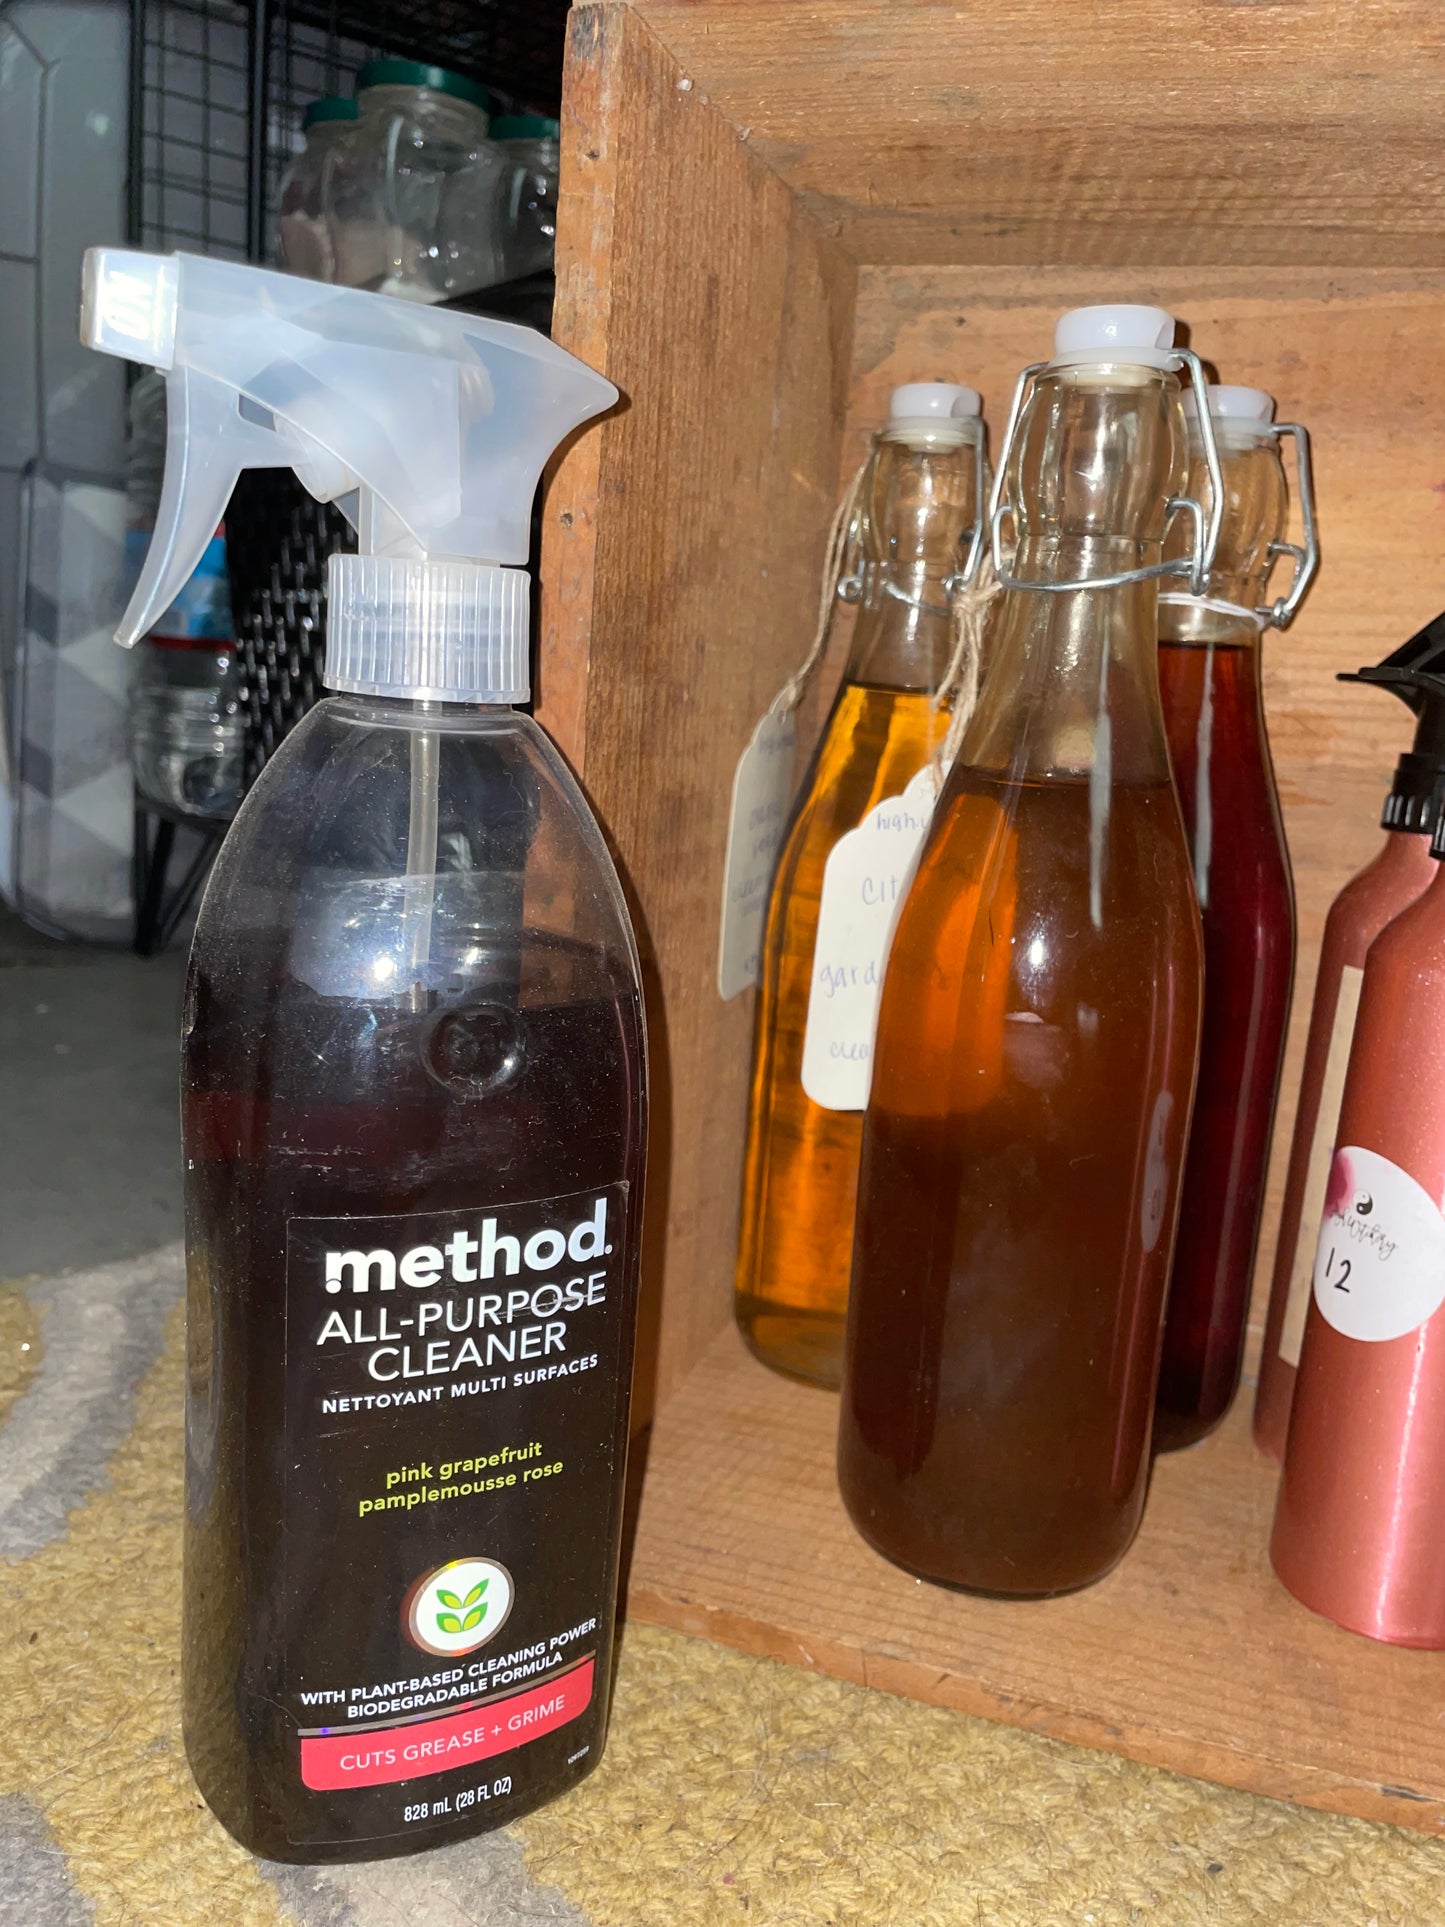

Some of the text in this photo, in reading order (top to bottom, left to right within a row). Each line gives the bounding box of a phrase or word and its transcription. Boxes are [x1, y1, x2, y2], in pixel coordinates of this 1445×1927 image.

[1325, 1247, 1352, 1294] 12
[316, 1270, 607, 1346] ALL-PURPOSE
[367, 1321, 567, 1382] CLEANER
[322, 1353, 599, 1414] NETTOYANT MULTI SURFACES
[358, 1460, 564, 1517] pamplemousse rose
[386, 1441, 543, 1489] pink grapefruit
[301, 1617, 597, 1706] WITH PLANT-BASED CLEANING POWER
[347, 1652, 563, 1719] BIODEGRADABLE FORMULA
[339, 1694, 566, 1772] CUTS GREASE + GRIME
[403, 1776, 513, 1823] 828 mL (28 FL OZ)
